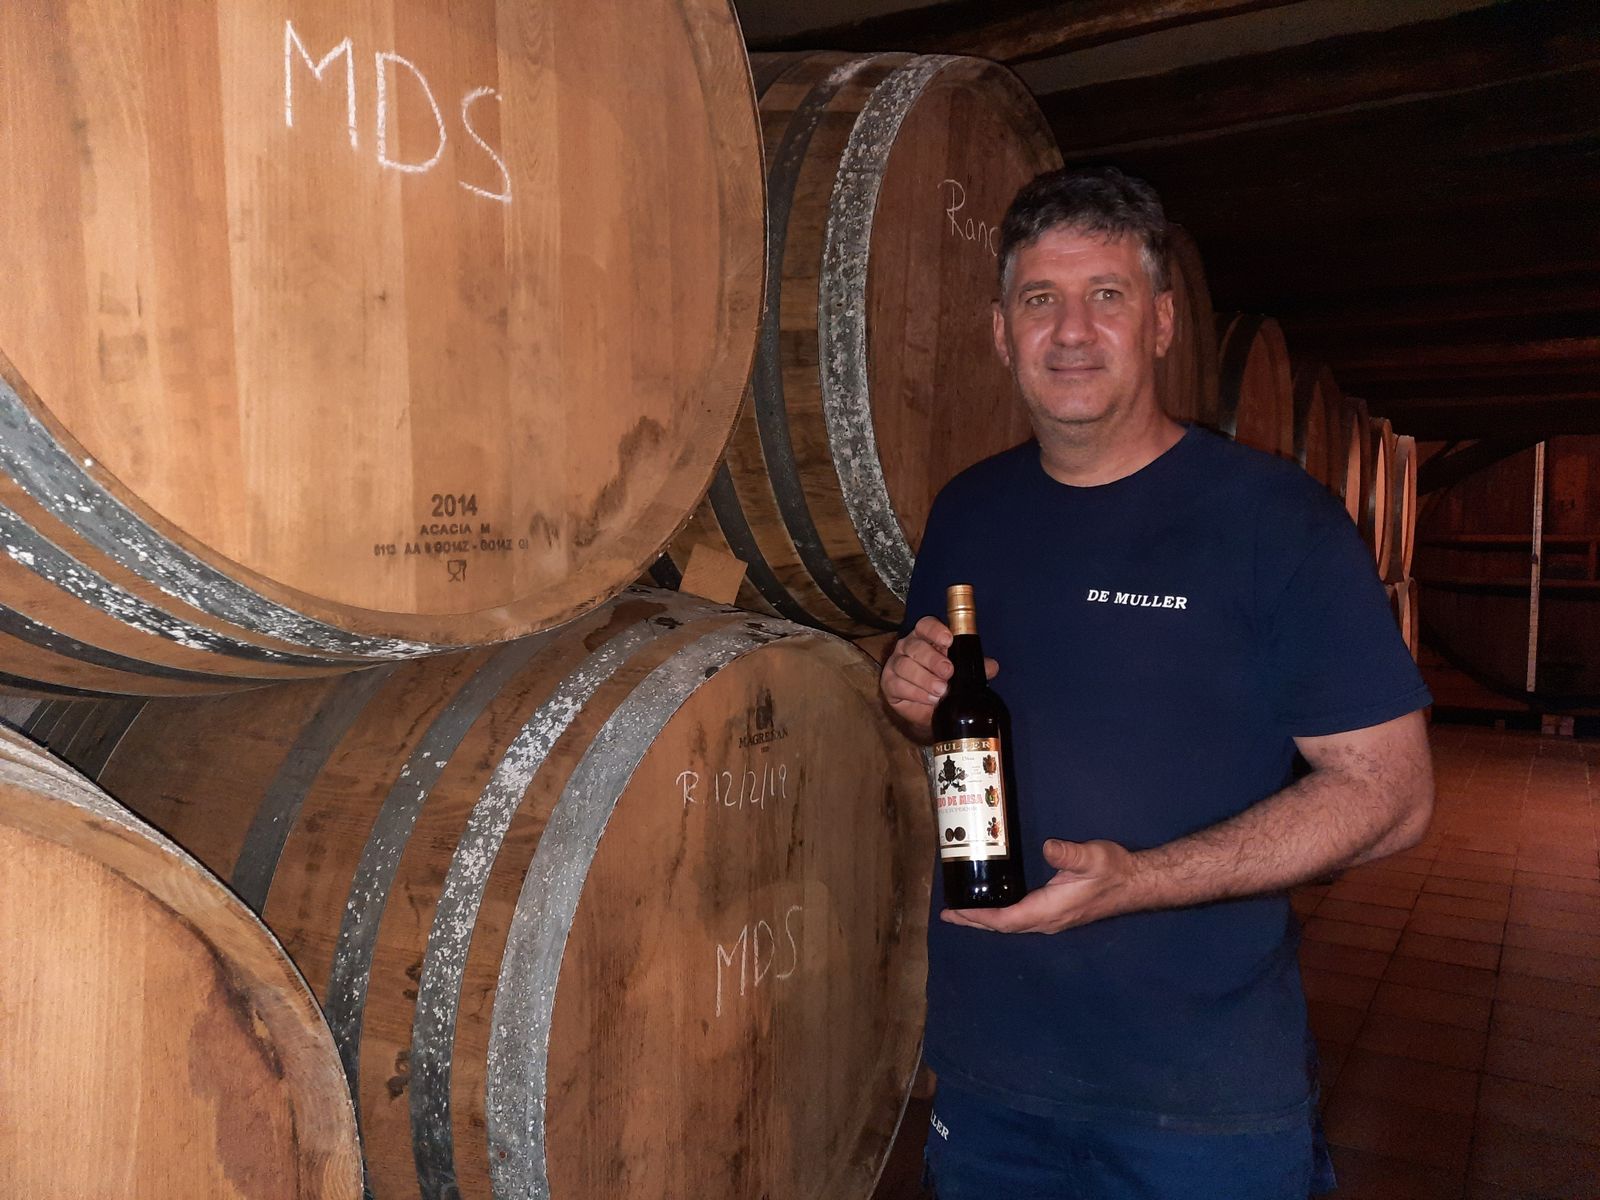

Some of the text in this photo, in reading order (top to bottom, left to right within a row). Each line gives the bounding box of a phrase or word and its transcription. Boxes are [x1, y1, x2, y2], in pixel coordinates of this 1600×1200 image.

[284, 19, 513, 203] MDS
[937, 179, 999, 257] Ranc
[431, 493, 478, 517] 2014
[420, 523, 491, 536] ACACIA M
[1087, 589, 1188, 610] DE MULLER
[715, 762, 787, 810] 12/2/19
[948, 795, 957, 806] DE
[714, 904, 803, 1018] MDS
[930, 1108, 950, 1141] LLER
